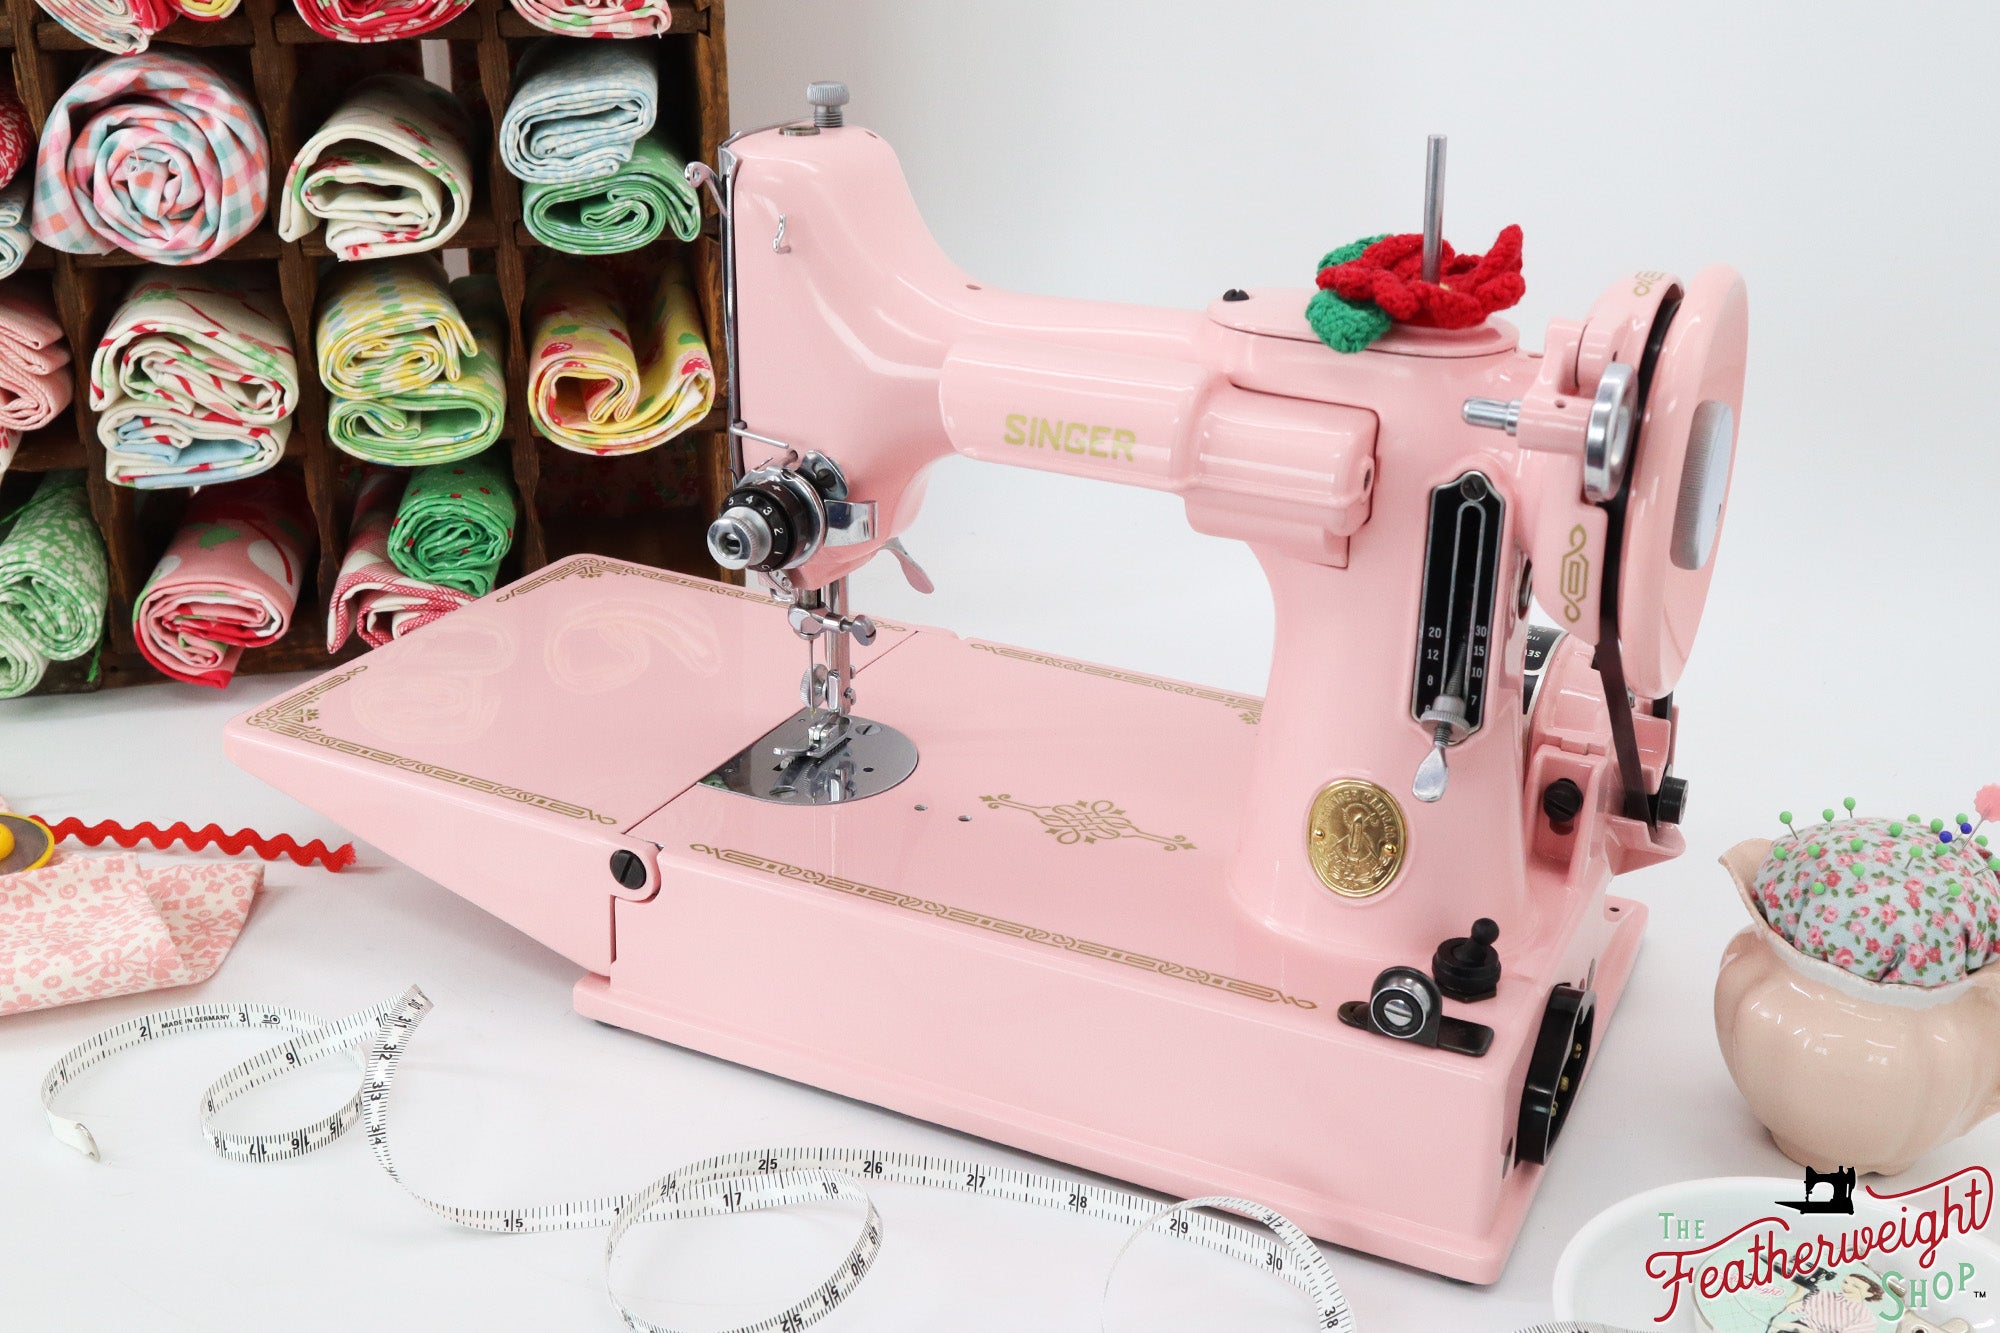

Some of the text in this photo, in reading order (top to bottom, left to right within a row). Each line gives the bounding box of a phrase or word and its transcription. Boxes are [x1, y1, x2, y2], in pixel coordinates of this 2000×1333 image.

[1004, 413, 1137, 462] SINGER
[728, 496, 734, 506] 5
[745, 495, 754, 504] 4
[763, 506, 773, 516] 3
[774, 527, 784, 536] 2
[1428, 626, 1442, 639] 20
[1475, 625, 1487, 638] 30
[1427, 649, 1439, 660] 12
[1473, 645, 1485, 657] 15
[1471, 667, 1483, 678] 10
[1427, 675, 1434, 686] 8
[1471, 696, 1478, 706] 7
[161, 1019, 184, 1029] MADE
[194, 1014, 230, 1023] GERMANY
[238, 1012, 247, 1023] 3
[394, 1016, 412, 1028] 31
[139, 1026, 148, 1038] 2
[286, 1052, 295, 1065] 9
[379, 1043, 397, 1060] 32
[370, 1081, 384, 1101] 33
[207, 1100, 213, 1112] 8
[329, 1118, 344, 1136] 15
[371, 1124, 382, 1145] 34
[291, 1134, 310, 1150] 16
[249, 1143, 268, 1156] 17
[758, 1158, 778, 1170] 25
[863, 1160, 883, 1174] 26
[660, 1179, 676, 1196] 24
[966, 1173, 986, 1188] 27
[822, 1182, 839, 1194] 18
[723, 1192, 742, 1207] 17
[1068, 1193, 1088, 1209] 28
[503, 1218, 524, 1228] 15
[1169, 1218, 1189, 1234] 29
[1262, 1214, 1283, 1228] 37
[850, 1253, 866, 1277] 50
[1266, 1252, 1283, 1271] 30
[822, 1285, 841, 1307] 51
[780, 1313, 803, 1333] 52
[1324, 1306, 1339, 1329] 38
